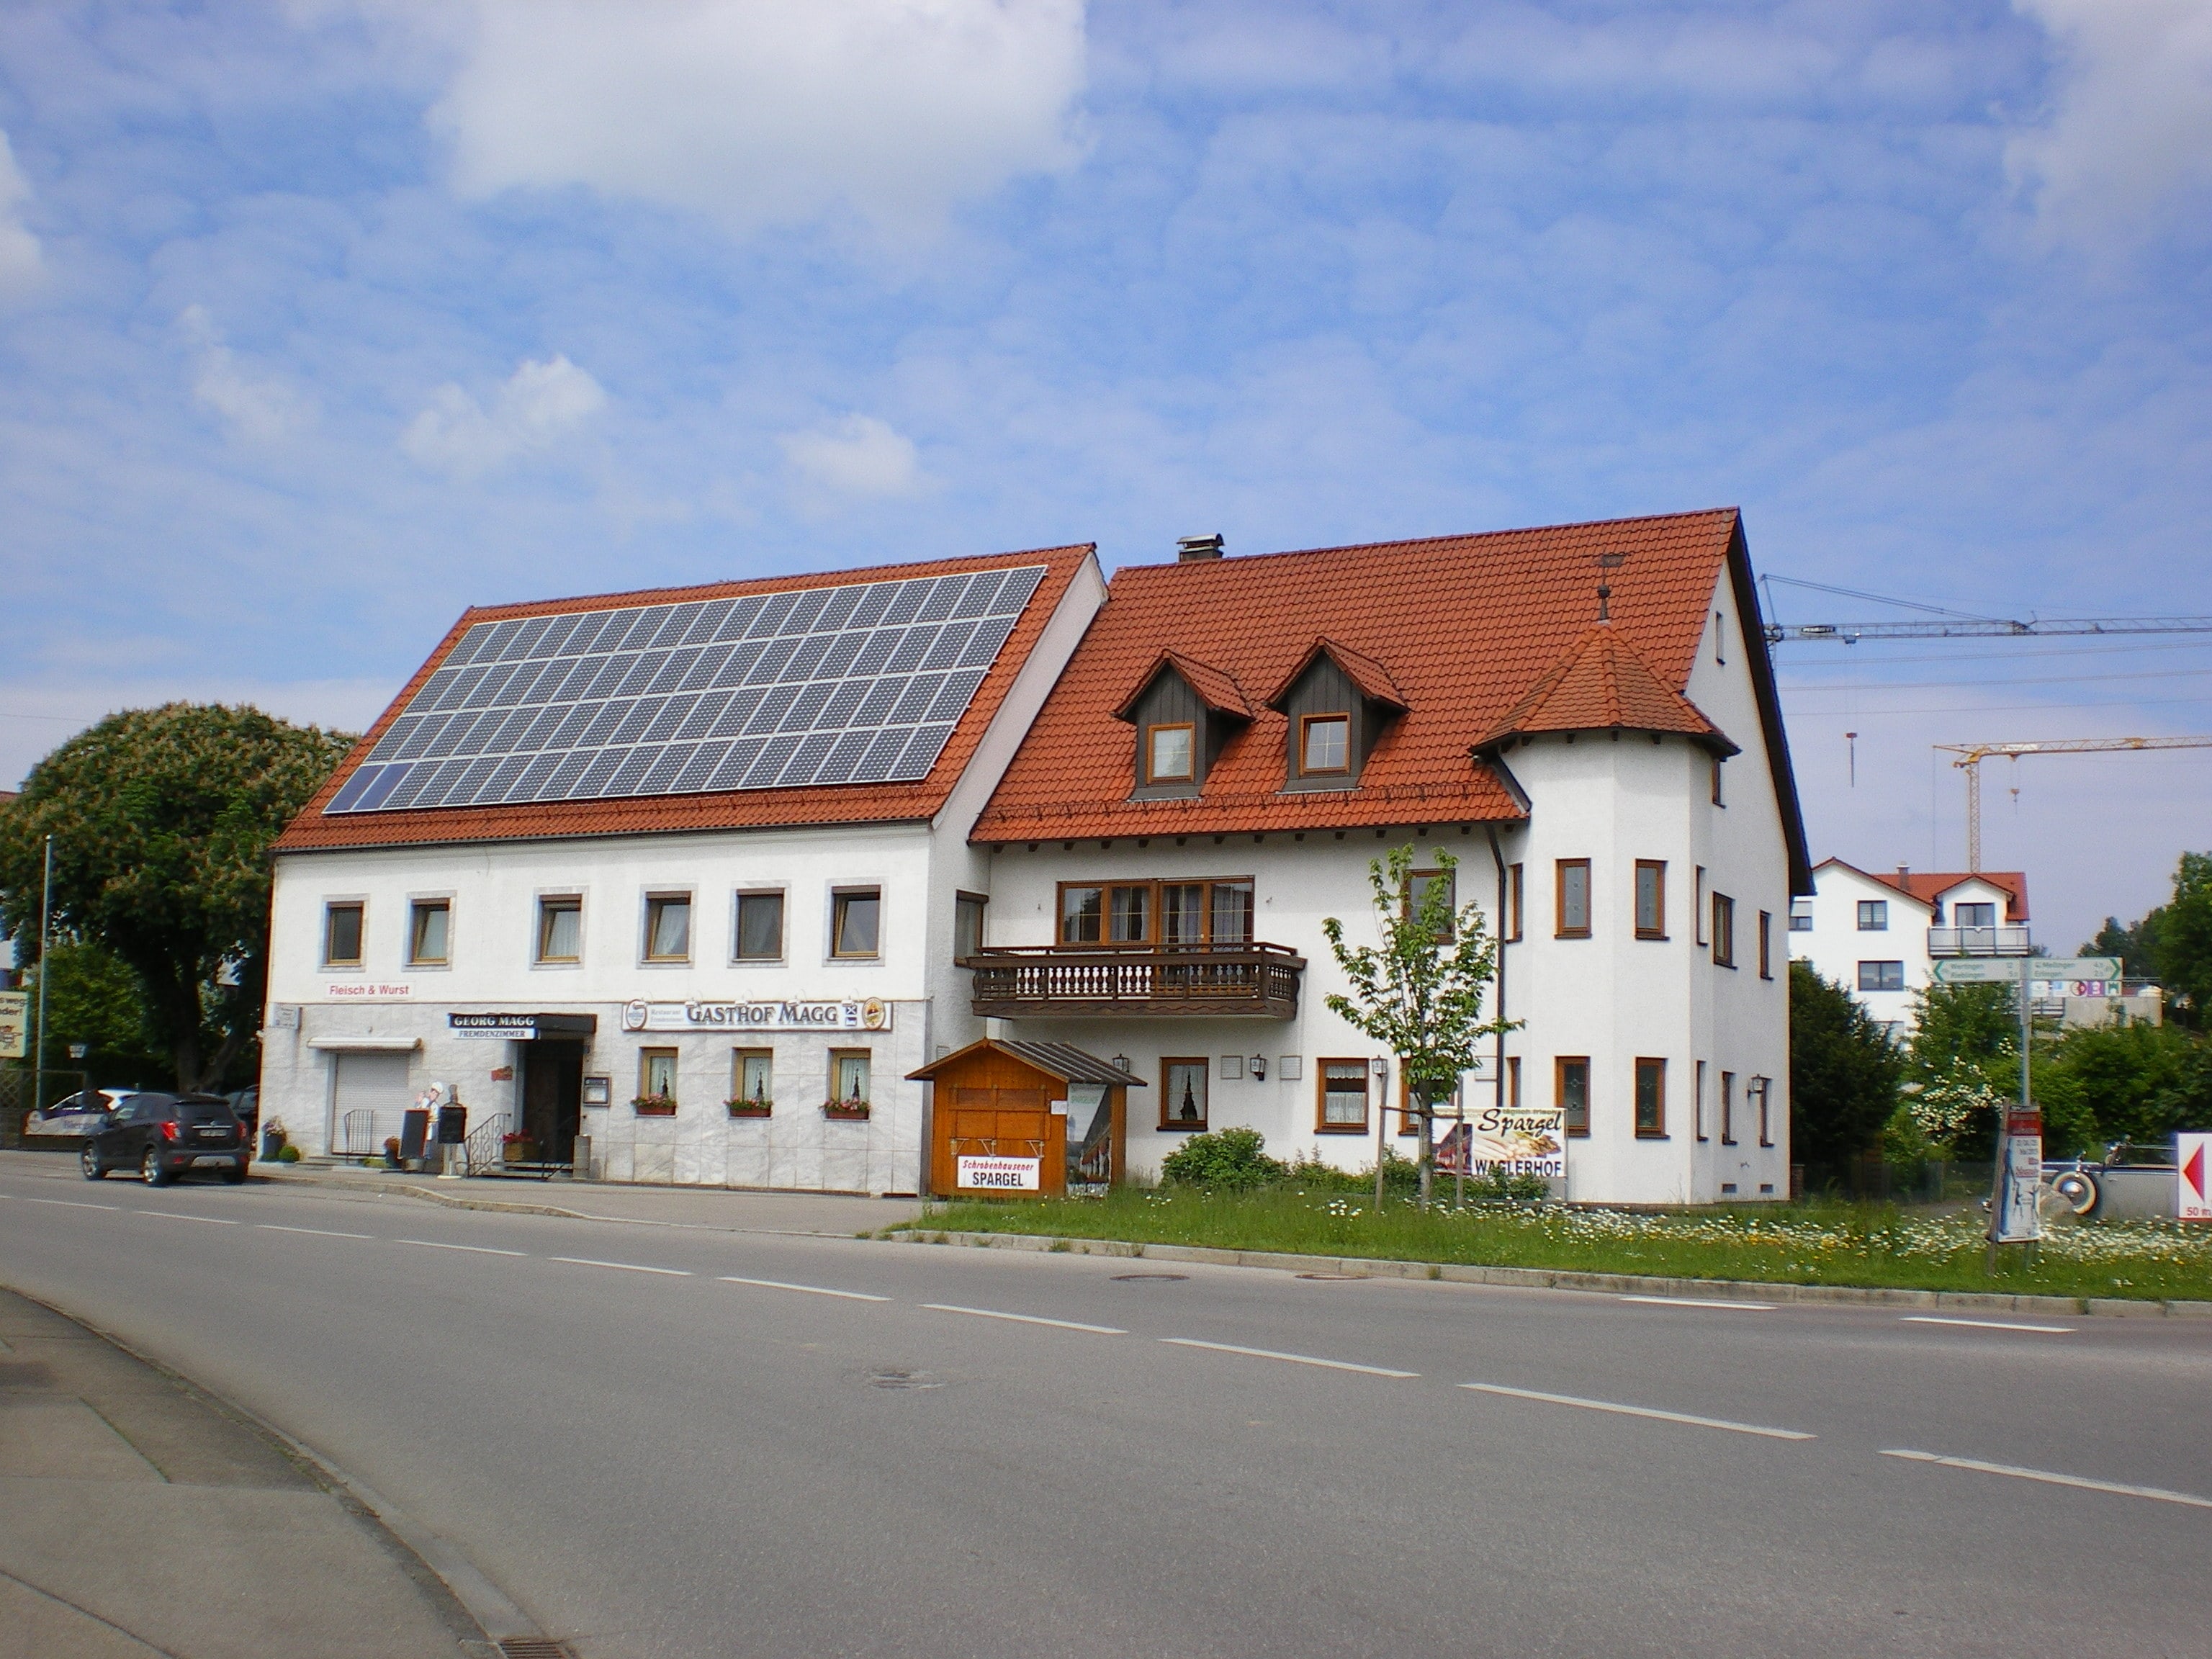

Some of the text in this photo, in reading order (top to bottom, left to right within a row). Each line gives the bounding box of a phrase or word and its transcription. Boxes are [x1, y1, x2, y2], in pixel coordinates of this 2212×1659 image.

[329, 985, 409, 994] Fleisch & Wurst
[687, 1002, 838, 1022] GASTHOF MAGG
[454, 1016, 534, 1026] GEORG MAGG
[1478, 1108, 1562, 1138] Spargel
[963, 1160, 1034, 1172] Schrobenhausener
[973, 1172, 1023, 1187] SPARGEL
[2187, 1207, 2199, 1216] 50
